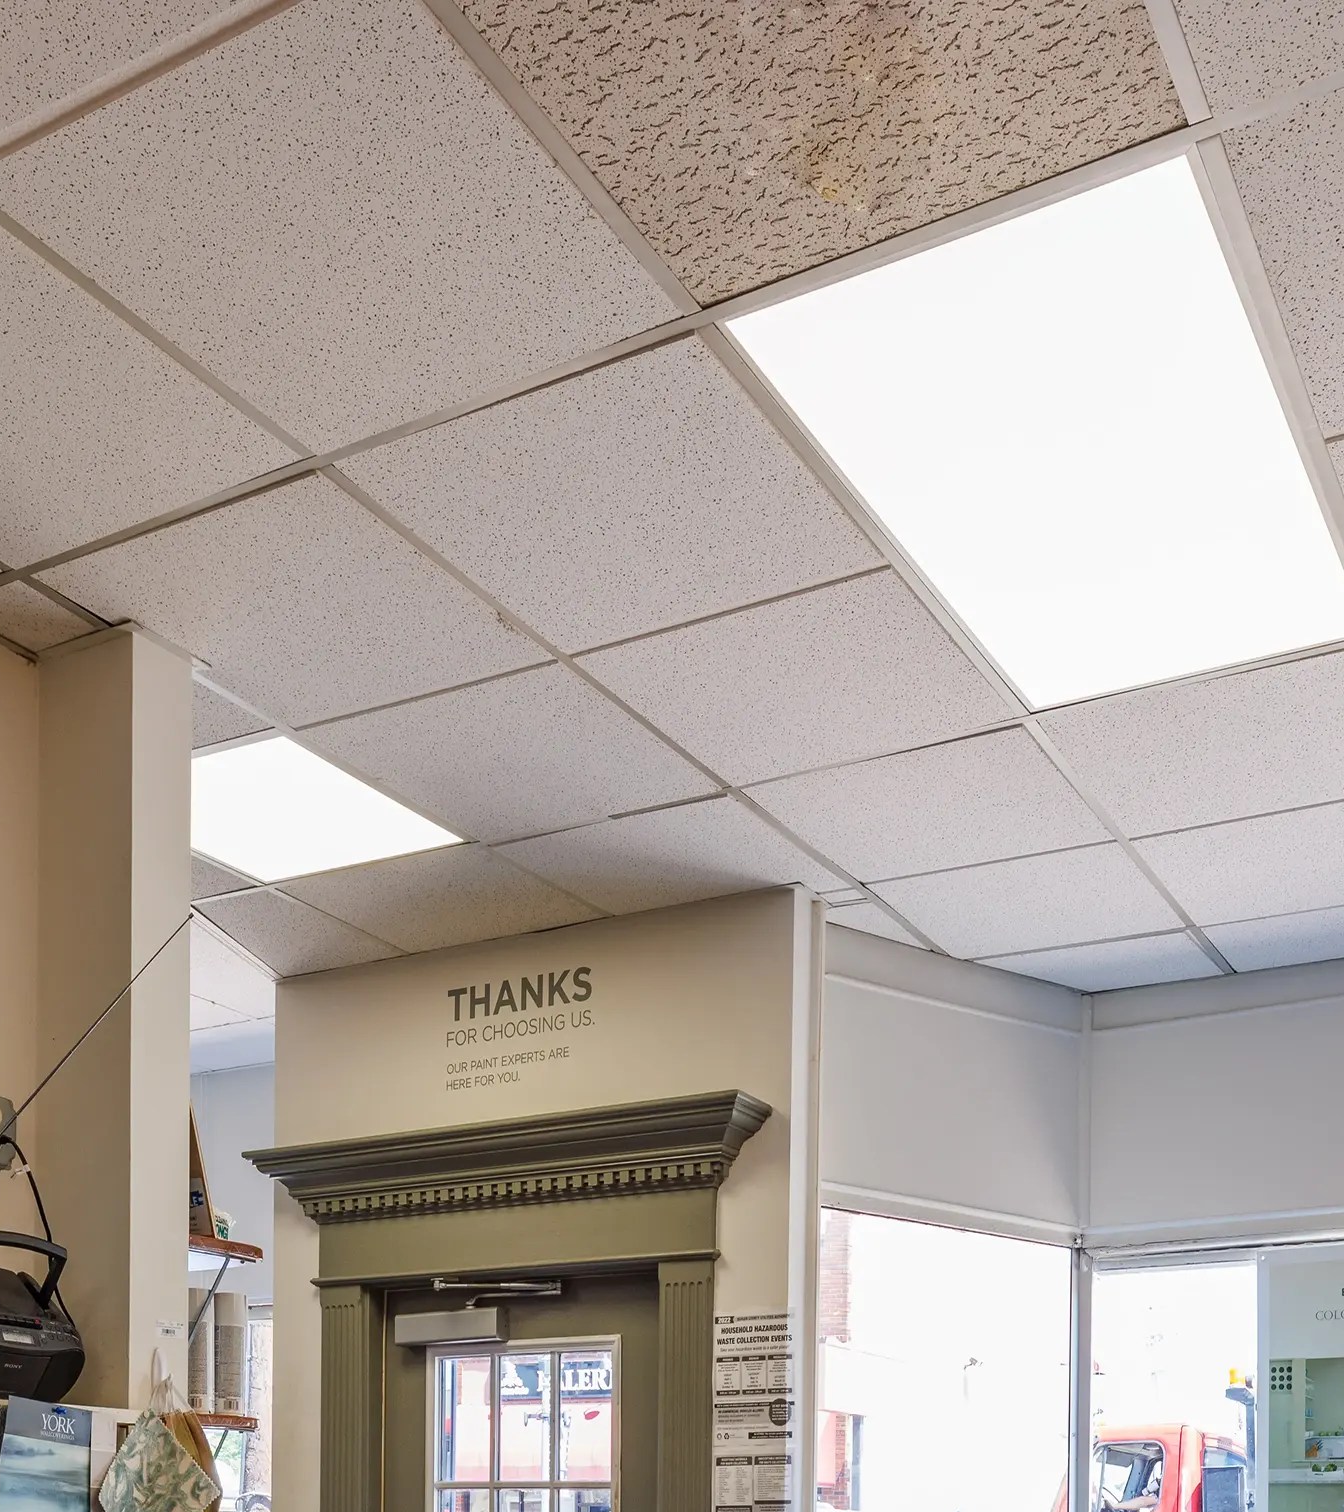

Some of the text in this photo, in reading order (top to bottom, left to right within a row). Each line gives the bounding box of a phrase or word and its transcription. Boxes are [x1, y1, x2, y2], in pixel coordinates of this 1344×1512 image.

[448, 967, 592, 1021] THANKS
[446, 1010, 595, 1048] FOR CHOOSING US.
[447, 1047, 569, 1075] OUR PAINT EXPERTS ARE
[446, 1071, 520, 1091] HERE FOR YOU.
[721, 1324, 788, 1334] HOUSEHOLD HAZARDOUS
[737, 1336, 769, 1344] COLLECTION
[41, 1413, 74, 1435] YORK
[40, 1430, 74, 1441] WALLCOVERINGS
